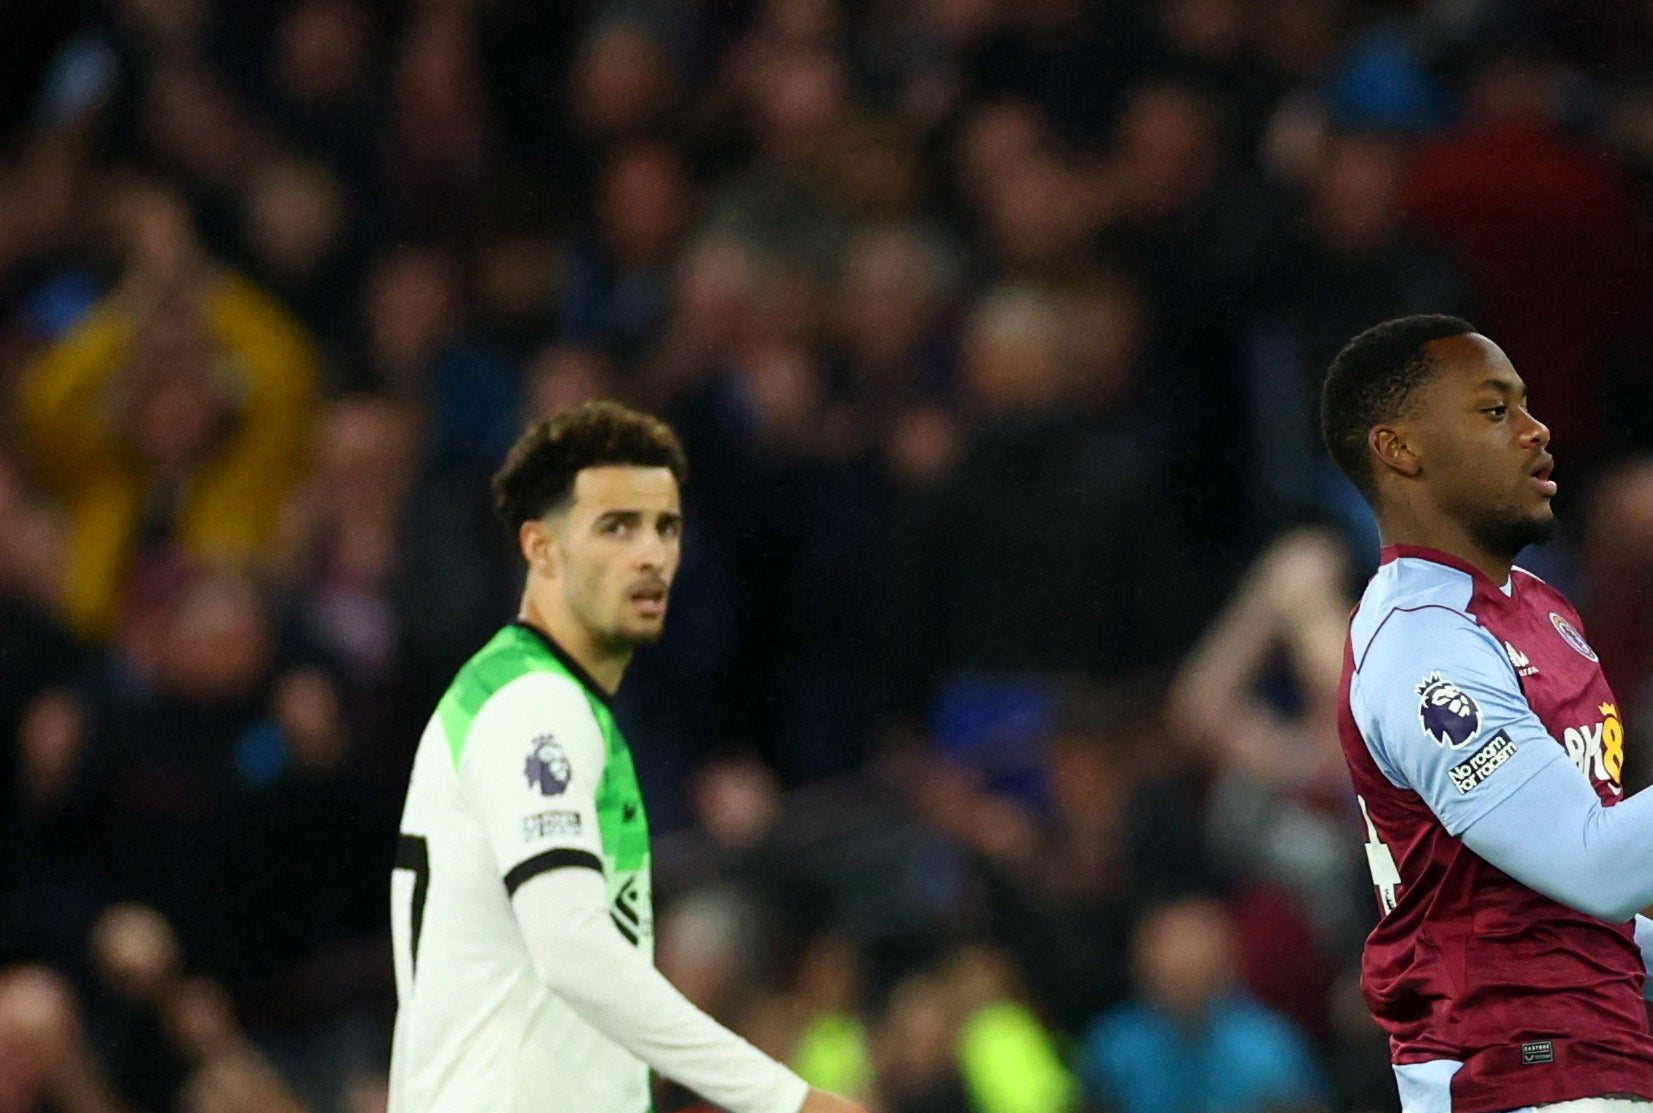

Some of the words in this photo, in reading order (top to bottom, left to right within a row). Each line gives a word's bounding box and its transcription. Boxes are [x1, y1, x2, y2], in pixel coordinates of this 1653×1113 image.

[1447, 764, 1472, 785] No
[1469, 736, 1507, 770] room
[1456, 773, 1478, 795] for
[1475, 741, 1518, 781] racism
[1563, 716, 1625, 783] BK8
